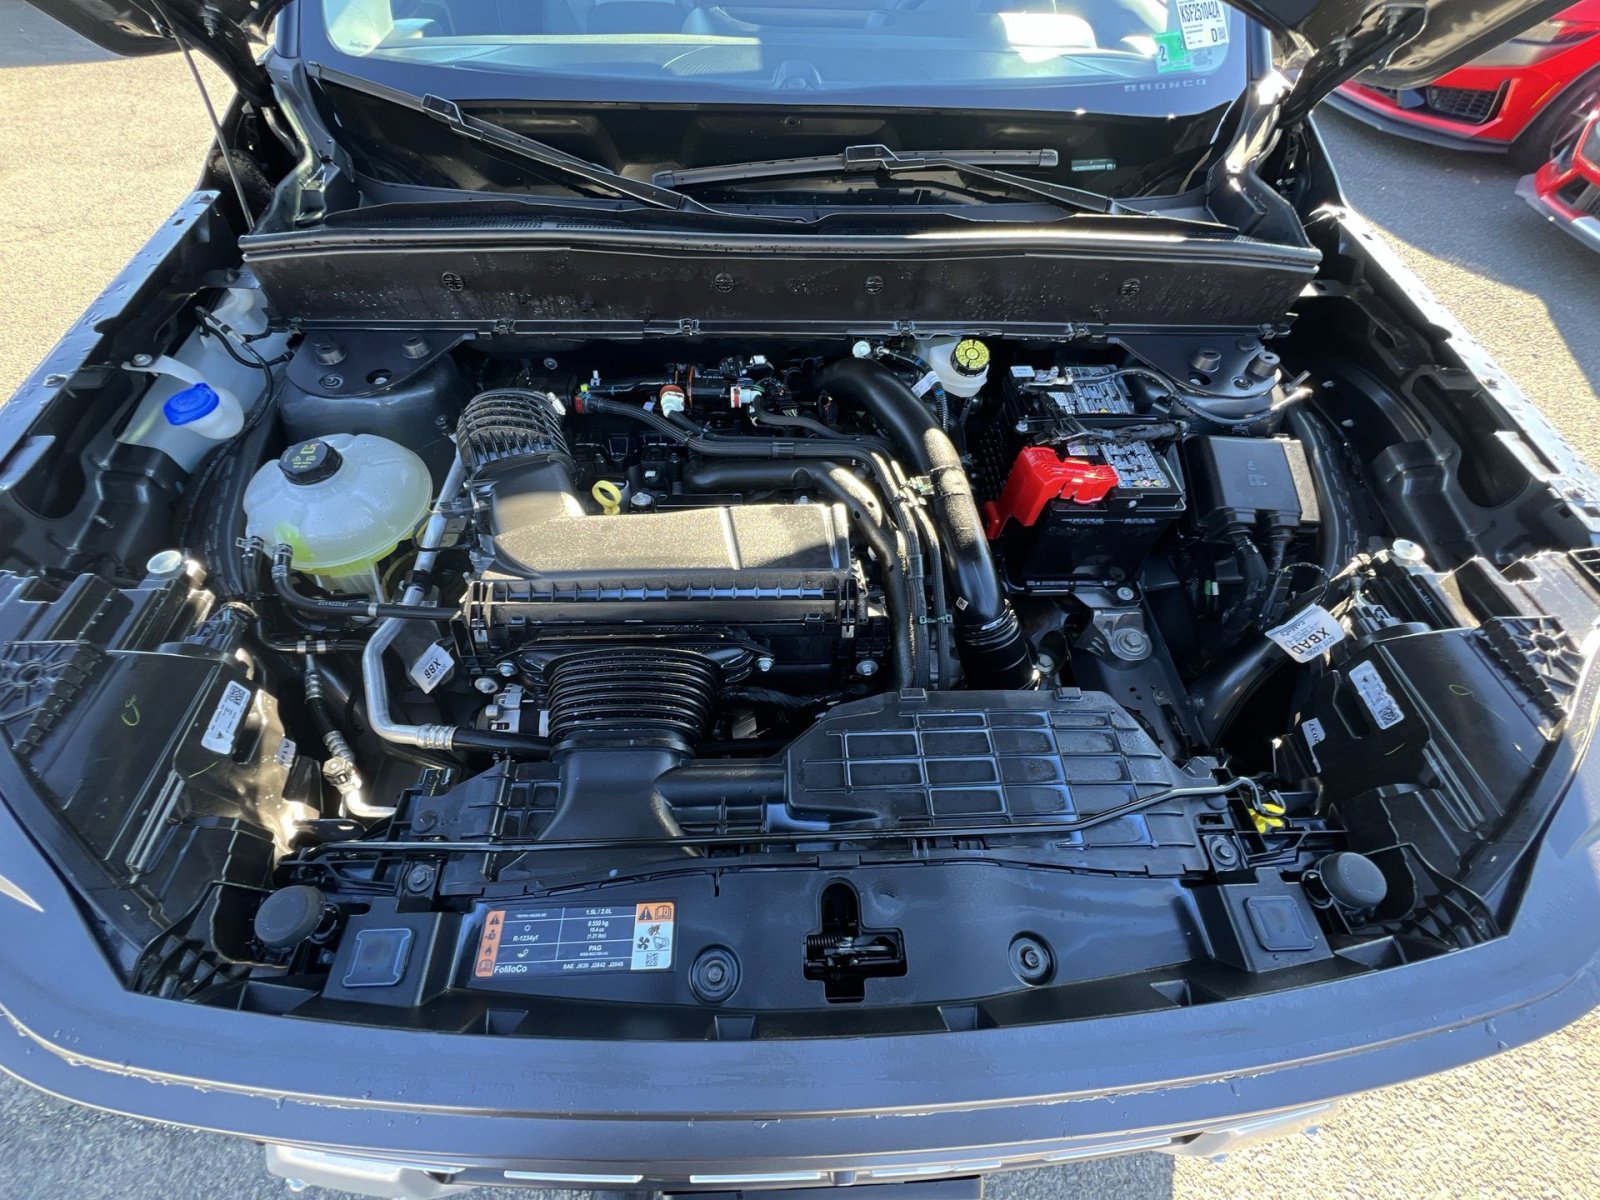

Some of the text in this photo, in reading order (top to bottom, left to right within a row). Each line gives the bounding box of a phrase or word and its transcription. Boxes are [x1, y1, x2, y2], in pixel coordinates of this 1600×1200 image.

[1210, 28, 1218, 42] D
[1159, 45, 1167, 61] 2
[1291, 626, 1331, 655] XBAD
[512, 934, 539, 942] R-1234yf
[494, 965, 527, 974] FoMoCo
